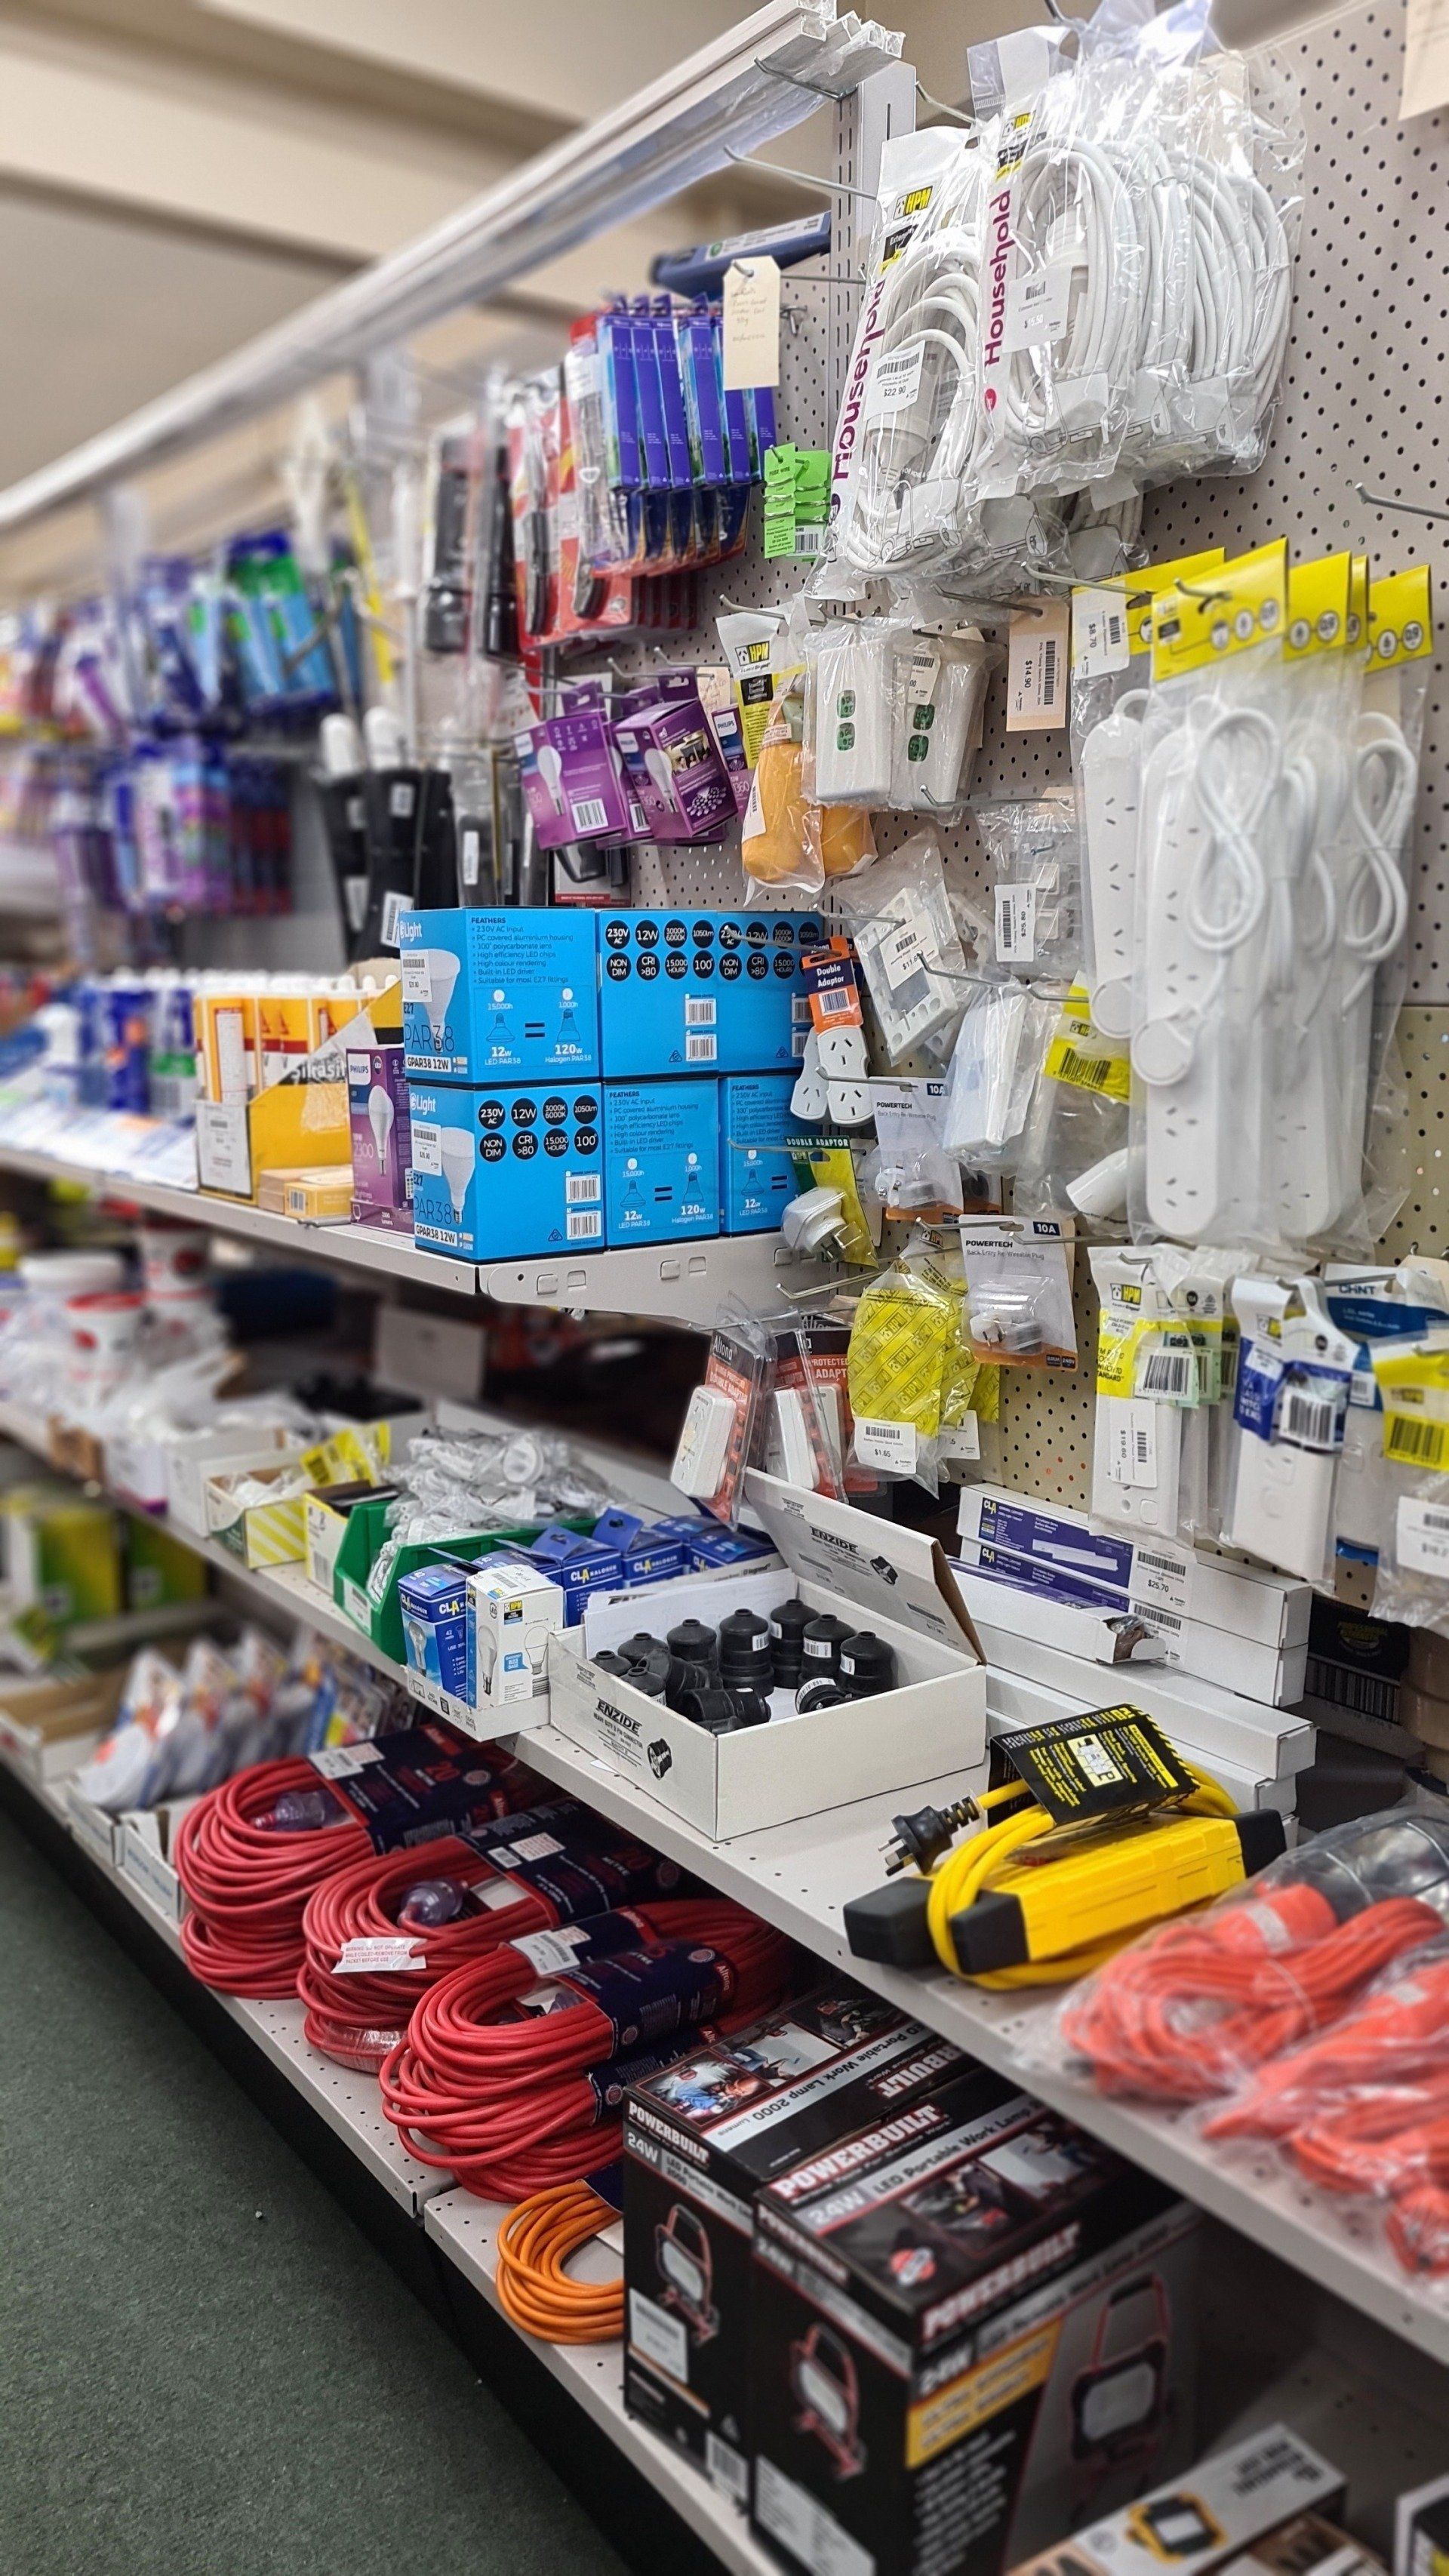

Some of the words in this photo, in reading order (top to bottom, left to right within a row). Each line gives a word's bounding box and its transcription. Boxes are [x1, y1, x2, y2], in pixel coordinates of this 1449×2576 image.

[906, 187, 932, 214] HPM
[985, 189, 1016, 367] Household
[884, 386, 906, 398] $22.90
[1088, 623, 1097, 648] $8.70
[749, 642, 769, 663] HPM
[718, 719, 734, 729] PHILIPS
[405, 922, 423, 942] Light
[607, 928, 629, 937] 230V
[636, 929, 659, 940] 12W
[610, 959, 628, 968] NON
[641, 955, 656, 965] CRI
[722, 959, 739, 968] NON
[752, 956, 764, 966] CRI
[902, 956, 919, 971] $11.6
[611, 967, 626, 976] DIM
[641, 966, 657, 976] >80
[667, 965, 686, 974] HOURS
[724, 967, 737, 976] DIM
[751, 966, 765, 975] >80
[817, 965, 841, 977] Double
[817, 975, 844, 988] Adaptor
[405, 1023, 455, 1054] PAR38
[349, 1063, 369, 1075] PHILIPS
[408, 1057, 432, 1069] GPAR38
[433, 1057, 450, 1070] 12W
[417, 1095, 436, 1116] Light
[480, 1107, 504, 1119] 230V
[512, 1107, 536, 1119] 12W
[574, 1105, 598, 1113] 1050lm
[545, 1110, 566, 1119] 6000K
[483, 1139, 503, 1149] NON
[518, 1135, 533, 1144] CRI
[816, 1138, 849, 1146] ADAPTOR
[485, 1148, 502, 1157] DIM
[517, 1146, 534, 1156] >80
[416, 1224, 439, 1240] GPAR38
[440, 1230, 457, 1244] 12W
[1037, 1223, 1057, 1233] 10A
[965, 1239, 1013, 1248] POWERTECH
[1121, 1285, 1141, 1305] HPM
[890, 1313, 906, 1336] HPM
[713, 1335, 733, 1360] Altona
[897, 1346, 915, 1365] HPM
[816, 1368, 847, 1379] ADAPT
[906, 1378, 922, 1397] HPM
[875, 1448, 891, 1457] $1.65
[983, 1500, 996, 1515] CLA
[811, 1528, 859, 1553] ENZIDE
[982, 1547, 995, 1563] CLA
[571, 1568, 590, 1583] CLA
[589, 1564, 617, 1576] HALOGEN
[634, 1559, 652, 1574] CLA
[1148, 1578, 1170, 1593] $25.70
[401, 1595, 411, 1611] CLA
[438, 1599, 459, 1615] CLA
[597, 1699, 641, 1733] ENZIDE
[858, 2031, 909, 2062] Portable
[823, 2059, 860, 2082] Work
[789, 2078, 826, 2100] Lamp
[755, 2101, 790, 2121] 2000
[629, 2101, 710, 2164] POWERBUILT
[718, 2117, 751, 2137] Lumens
[627, 2131, 658, 2163] 24W
[769, 2104, 942, 2199] POWERBUILT
[808, 2190, 865, 2225] 24W
[872, 2174, 904, 2193] LED
[903, 2144, 958, 2177] Portable
[958, 2125, 997, 2151] Work
